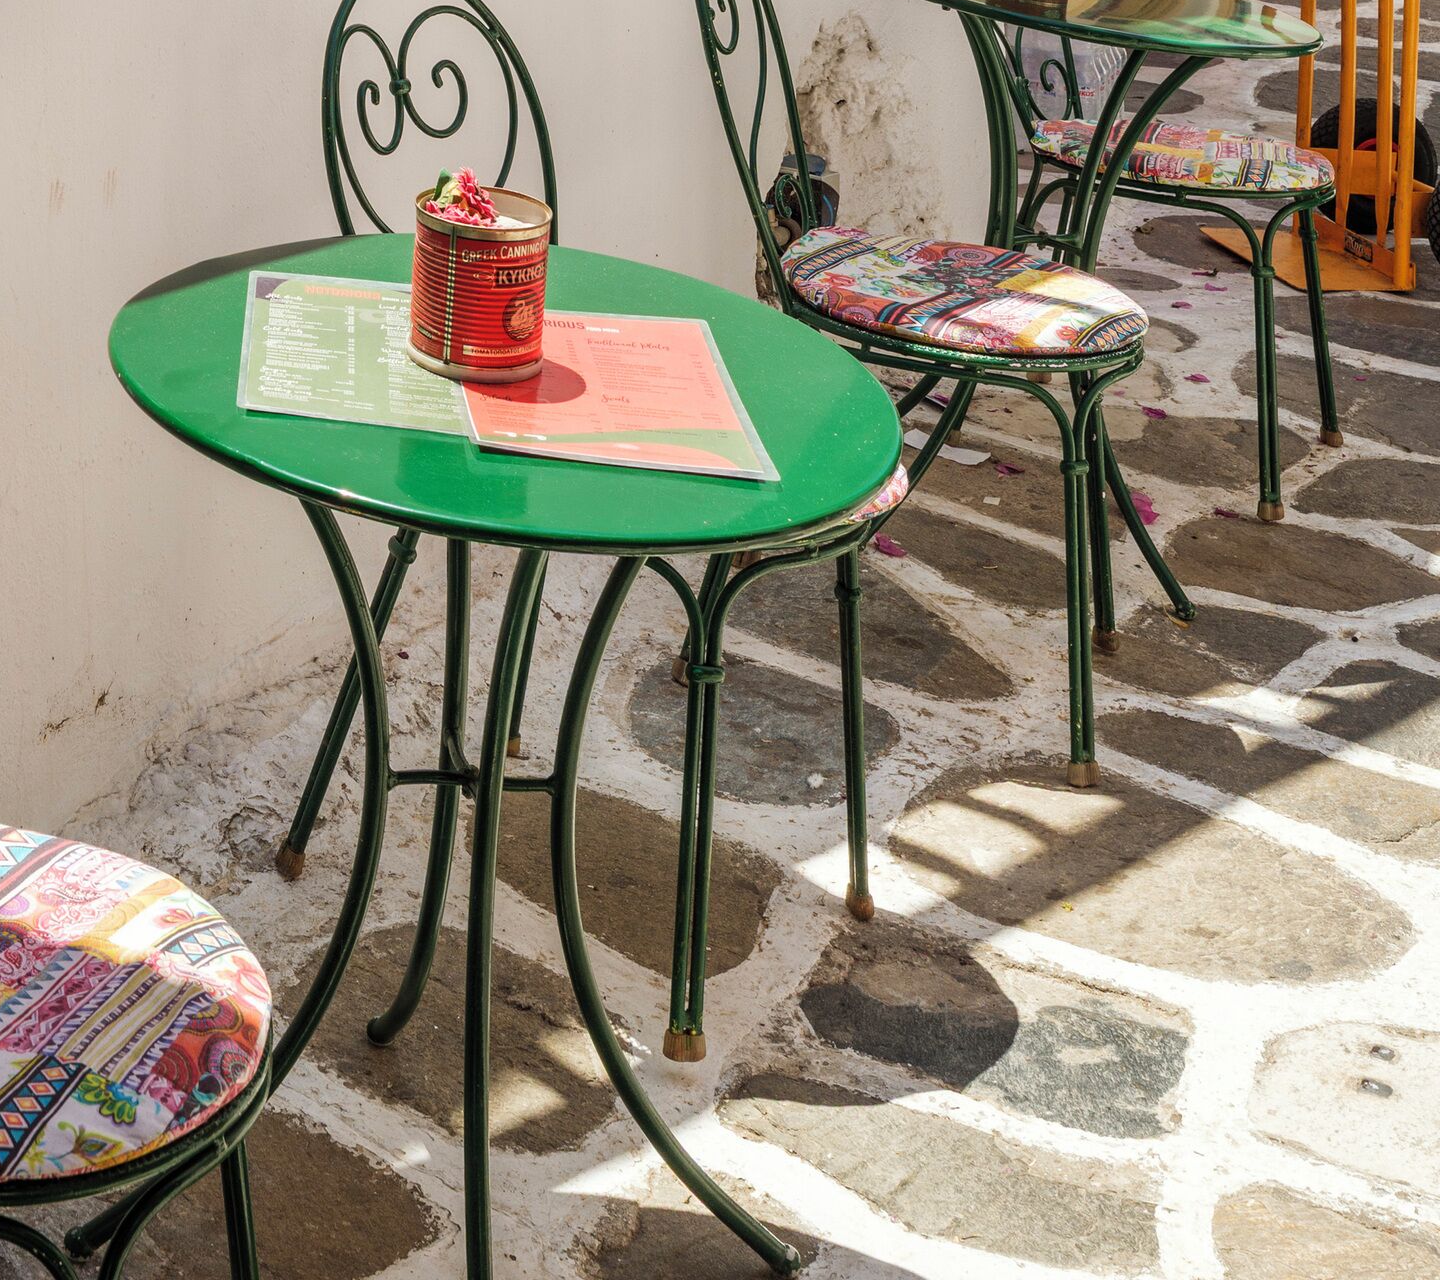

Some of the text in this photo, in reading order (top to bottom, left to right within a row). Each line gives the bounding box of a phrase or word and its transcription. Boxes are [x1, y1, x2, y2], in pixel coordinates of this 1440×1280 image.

[461, 248, 498, 263] GREEK
[500, 241, 541, 259] CANNING
[544, 319, 585, 330] RIOUS
